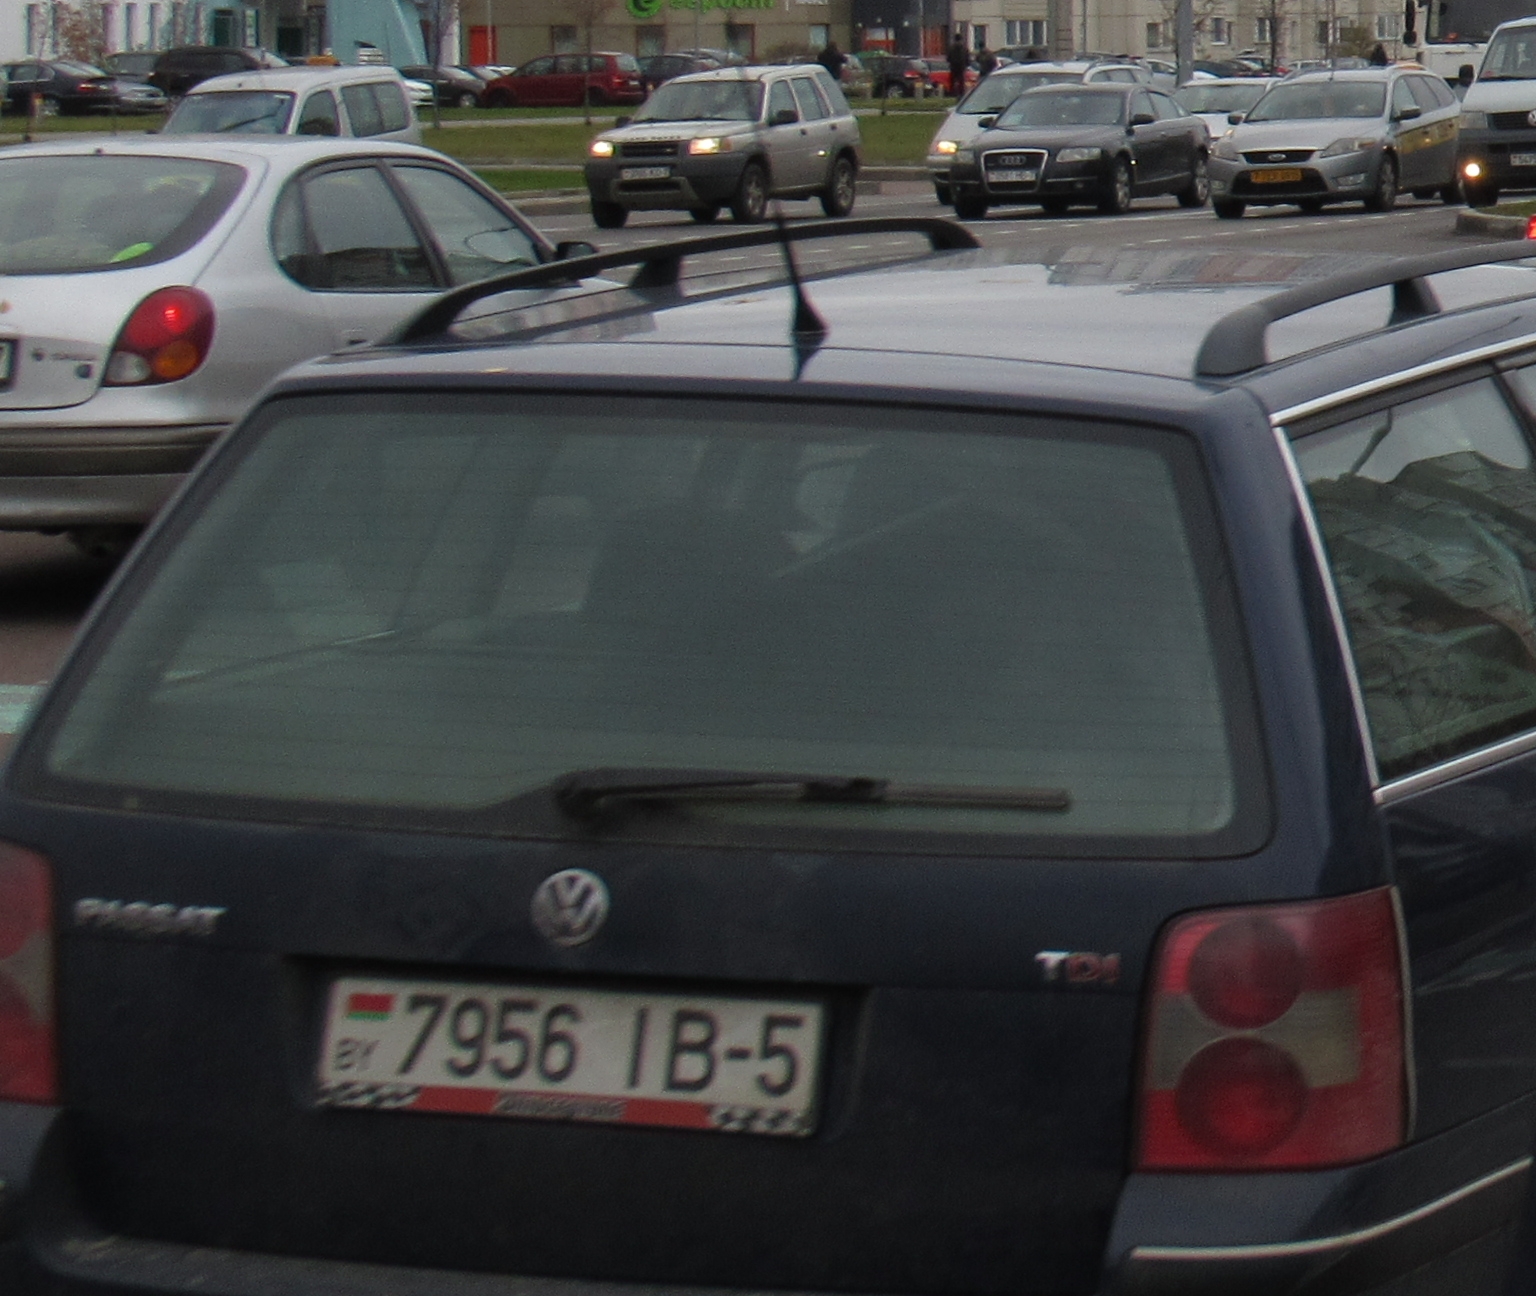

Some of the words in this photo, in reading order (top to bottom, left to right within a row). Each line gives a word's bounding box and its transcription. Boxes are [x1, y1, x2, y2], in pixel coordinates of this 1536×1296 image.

[335, 1037, 380, 1072] BY
[400, 993, 583, 1084] 7956
[627, 1007, 806, 1098] IB-5
